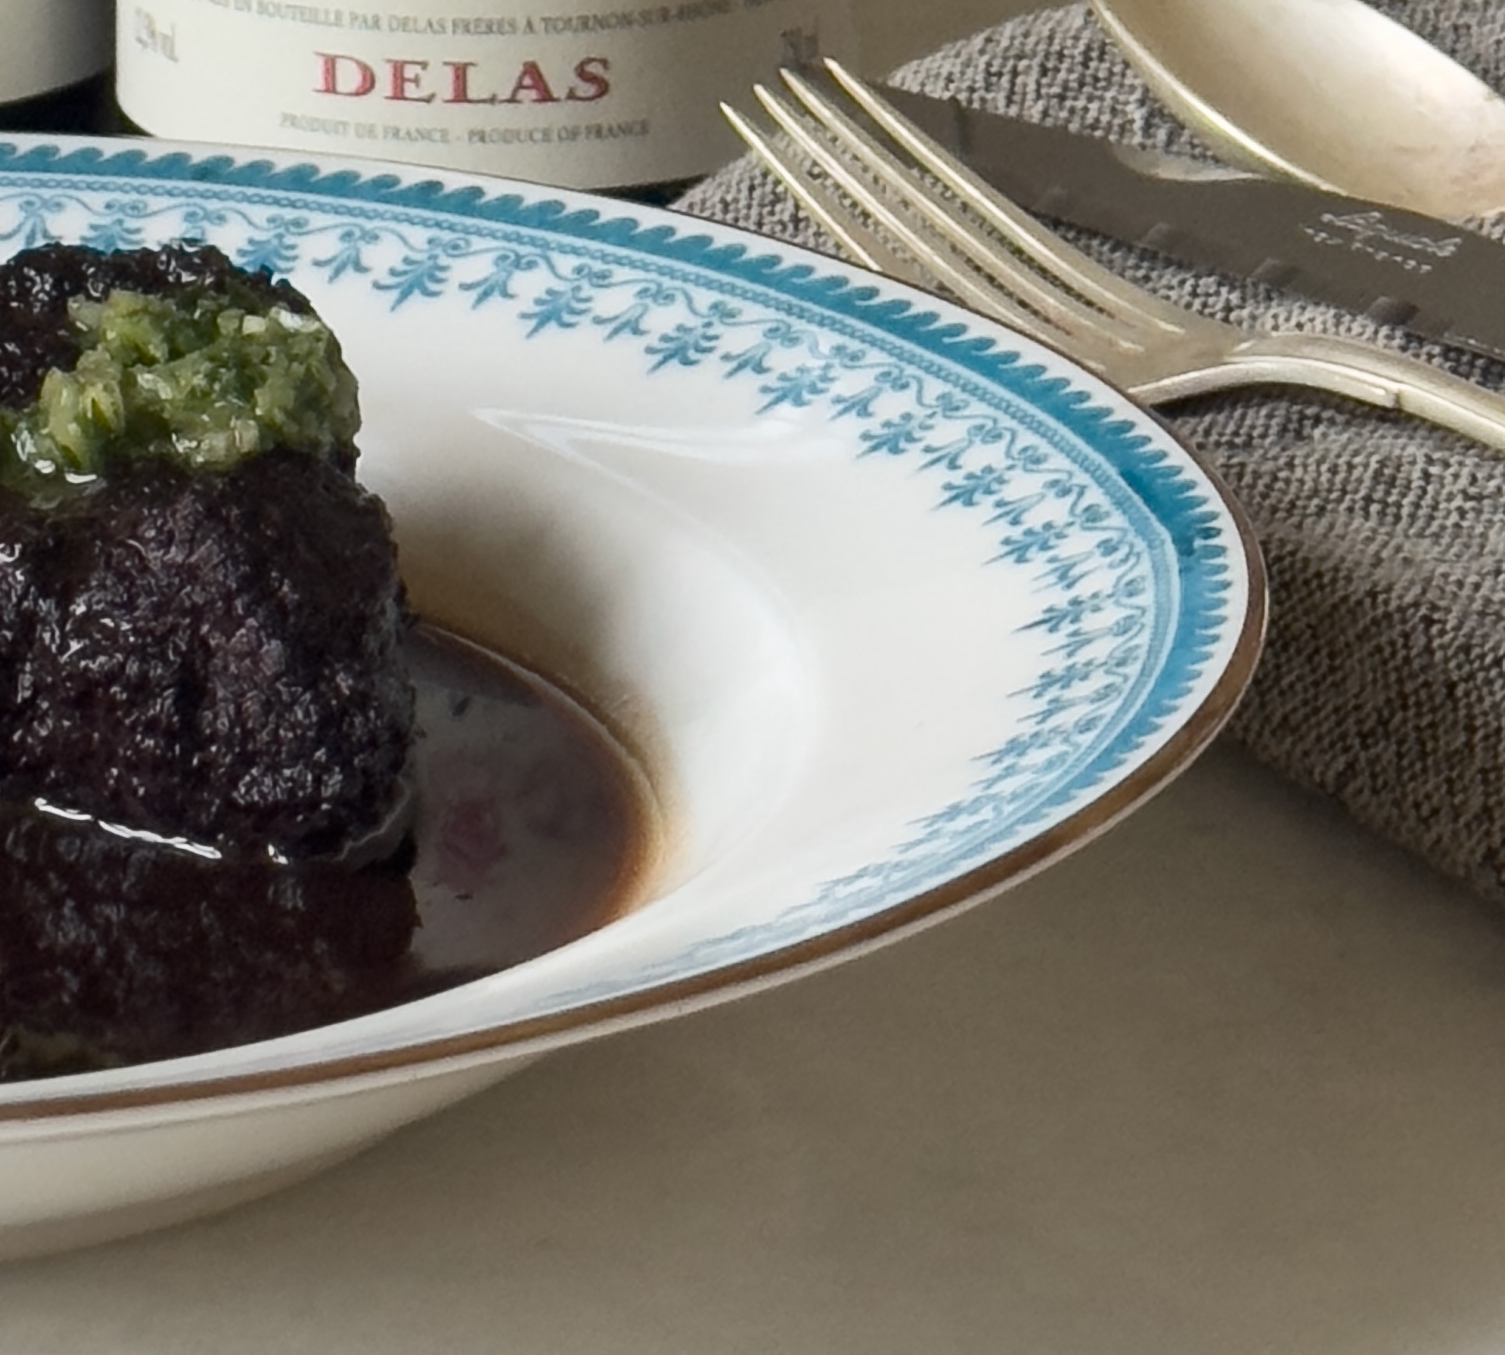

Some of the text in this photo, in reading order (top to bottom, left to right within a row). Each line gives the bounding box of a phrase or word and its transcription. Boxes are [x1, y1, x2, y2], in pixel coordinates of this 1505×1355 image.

[349, 10, 381, 31] PAR
[388, 13, 447, 35] DELAS
[312, 50, 611, 106] DELAS
[382, 124, 449, 144] FRANCE
[468, 127, 550, 144] PRODUCE
[555, 125, 581, 143] OF
[584, 119, 649, 142] FRANCE
